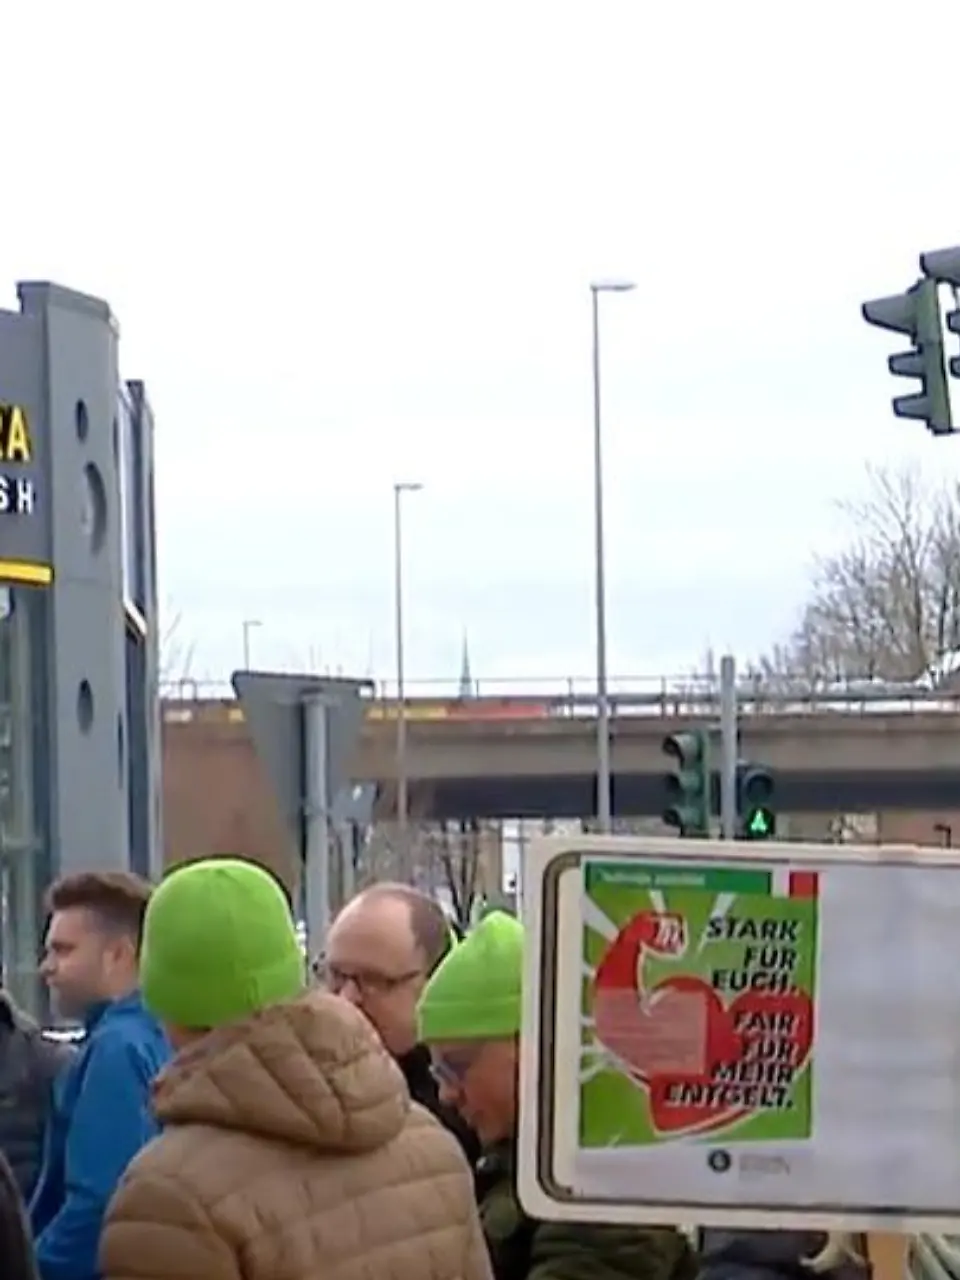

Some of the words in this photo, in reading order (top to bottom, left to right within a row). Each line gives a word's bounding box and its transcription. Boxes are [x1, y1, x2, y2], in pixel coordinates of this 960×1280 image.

[0, 404, 31, 461] A
[706, 916, 798, 941] STARK
[733, 1009, 796, 1034] FAIR
